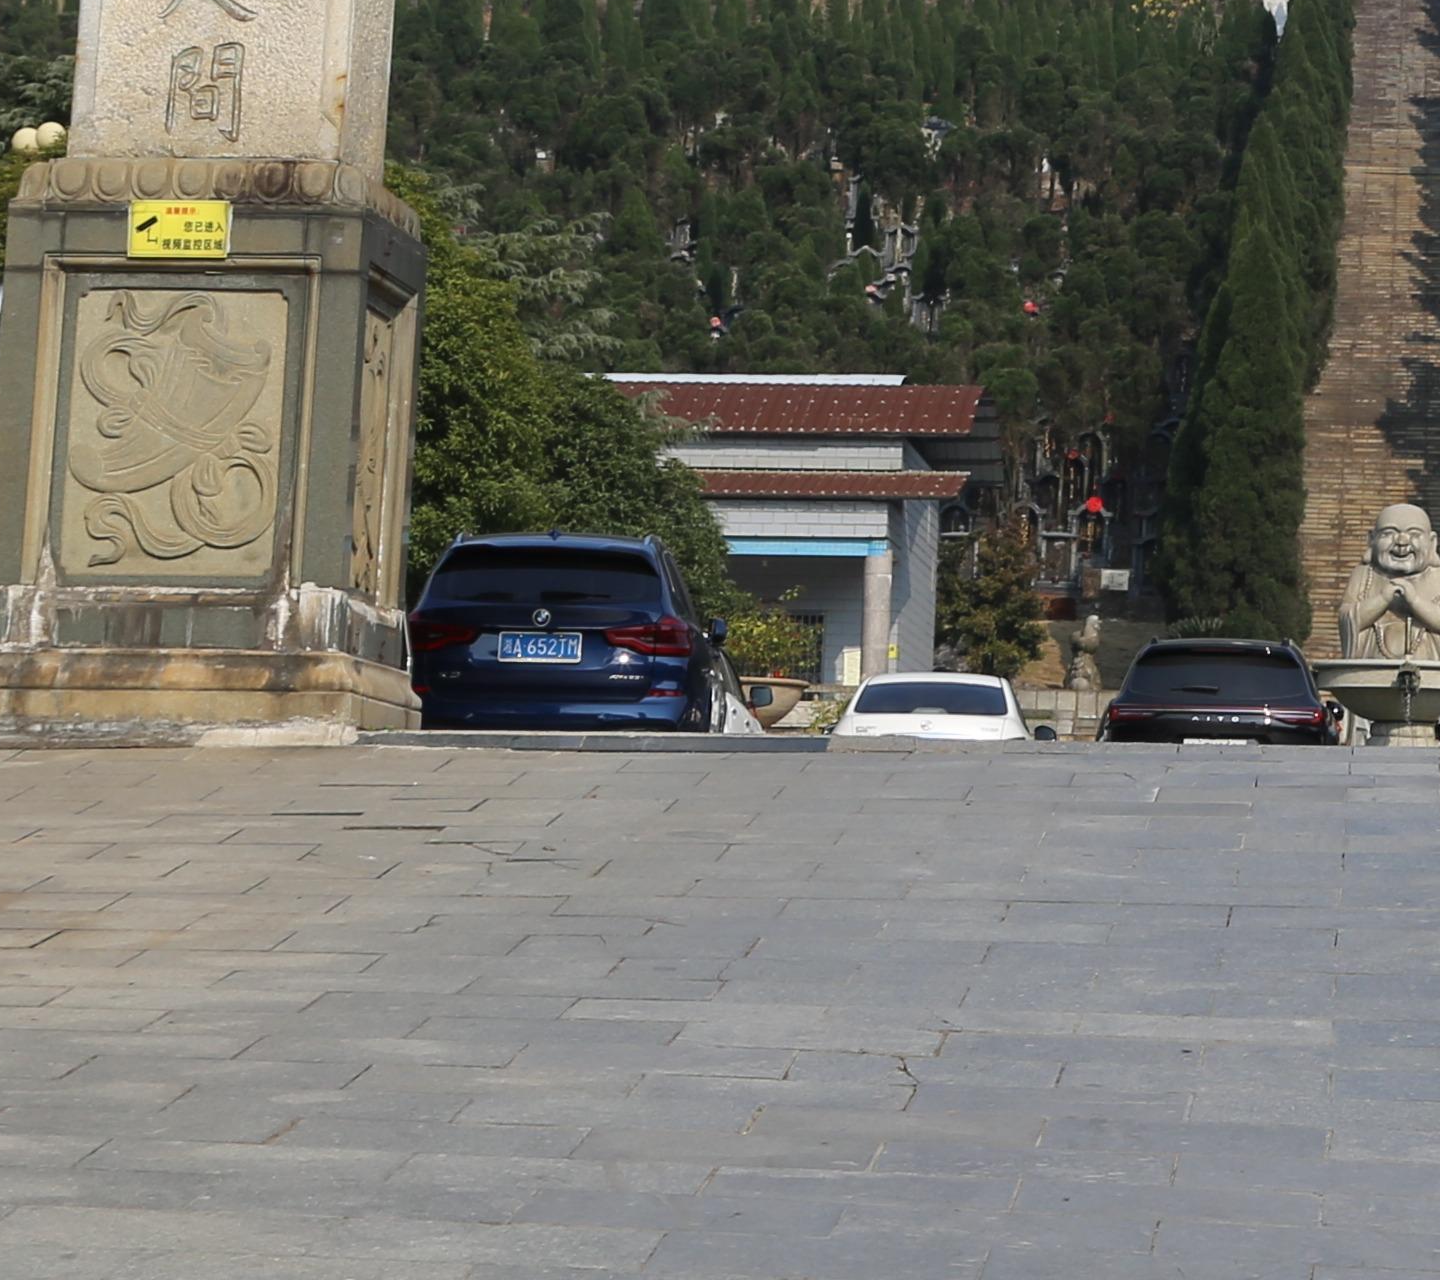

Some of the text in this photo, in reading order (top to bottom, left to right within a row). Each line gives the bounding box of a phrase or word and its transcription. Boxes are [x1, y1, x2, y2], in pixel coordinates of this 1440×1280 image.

[184, 221, 224, 233] 您已进入
[162, 238, 224, 251] 视频监控区域
